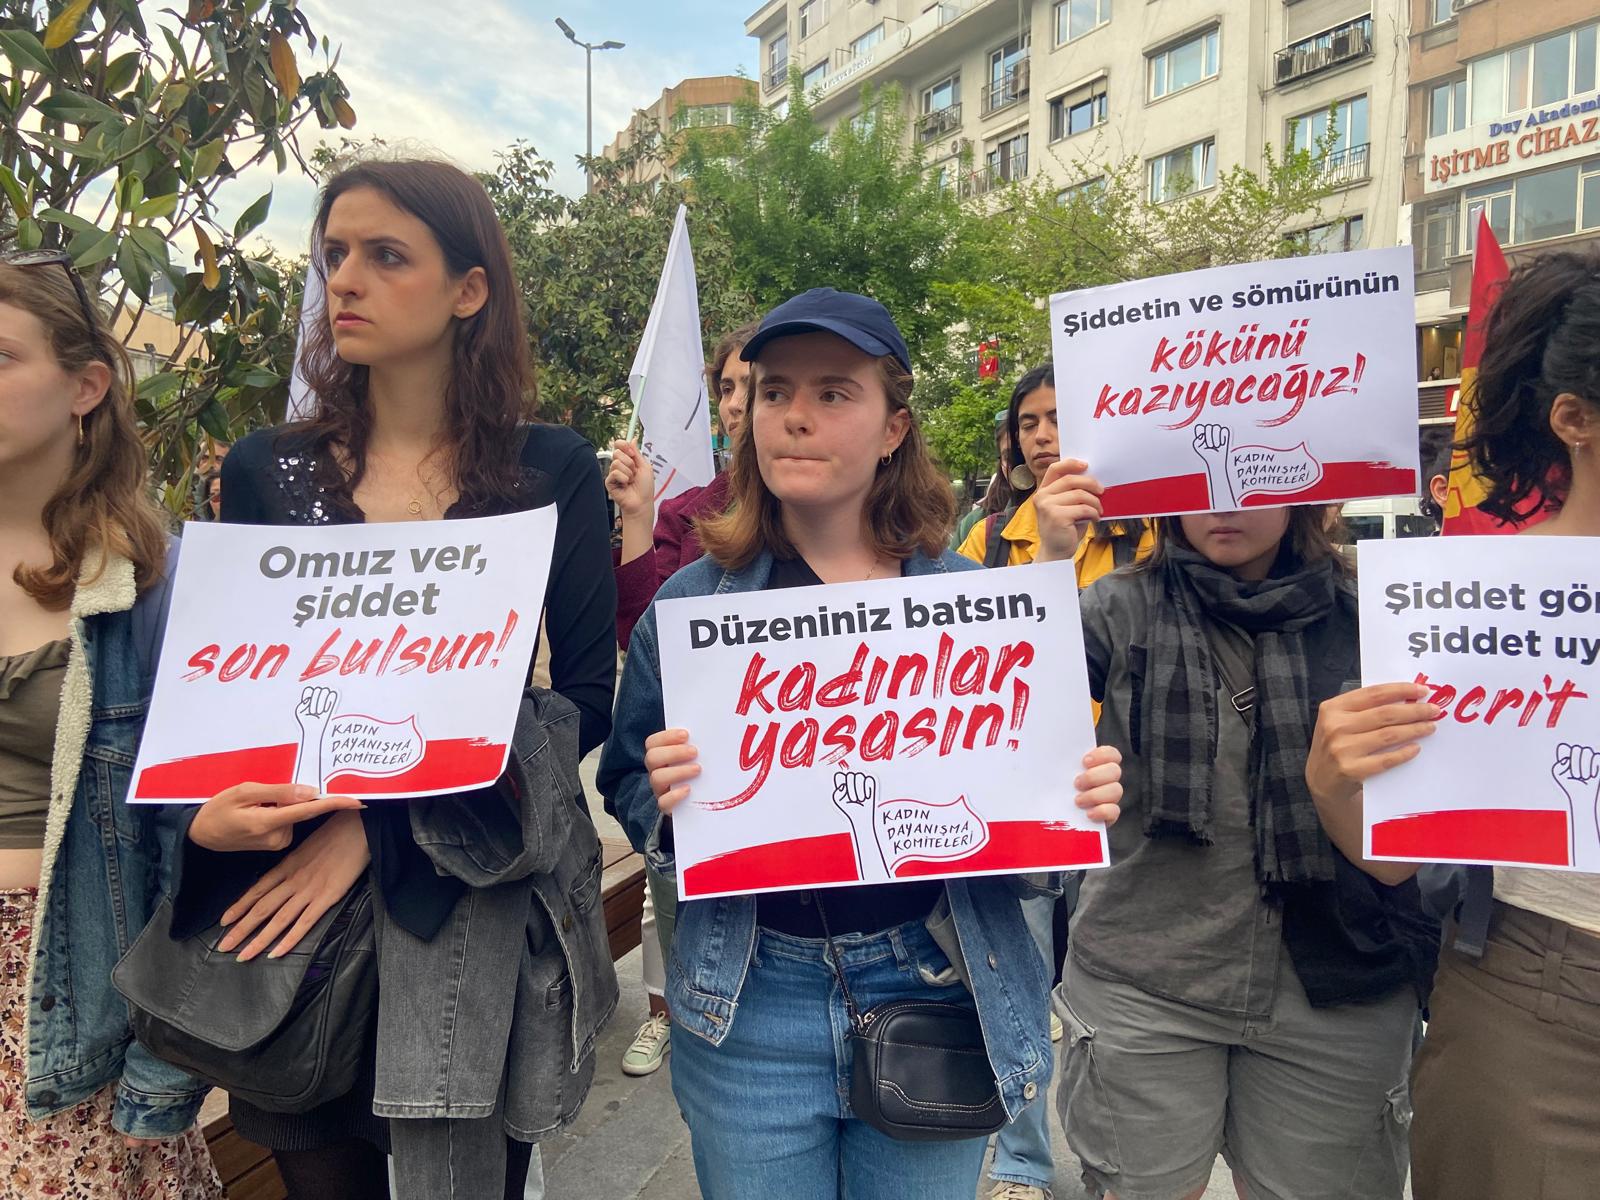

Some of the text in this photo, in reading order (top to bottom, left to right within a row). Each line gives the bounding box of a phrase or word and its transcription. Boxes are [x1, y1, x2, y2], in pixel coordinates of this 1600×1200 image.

[1489, 119, 1522, 137] Duy
[1430, 140, 1509, 183] İŞİTME
[1063, 271, 1400, 337] Şiddetin ve sömürünün
[1150, 318, 1311, 373] kökünü
[1093, 352, 1366, 430] kazıyacağız!
[1234, 453, 1275, 466] KADIN
[259, 543, 487, 579] Omuz ver,
[293, 583, 440, 627] şiddet
[1384, 581, 1526, 616] Şiddet
[689, 592, 1046, 649] Düzeniniz batsın,
[179, 608, 519, 683] son bulsun!
[1408, 625, 1541, 658] şiddet
[735, 631, 1035, 716] kadınlar
[332, 723, 379, 737] KADIN
[332, 737, 411, 753] DAYANIŞMA
[690, 676, 1030, 811] yaşasın!
[333, 749, 413, 767] KOMİTELERİ
[883, 809, 930, 825] KADIN
[887, 821, 969, 840] DAYANIŞMA
[893, 830, 973, 855] KOMİTELERİ
